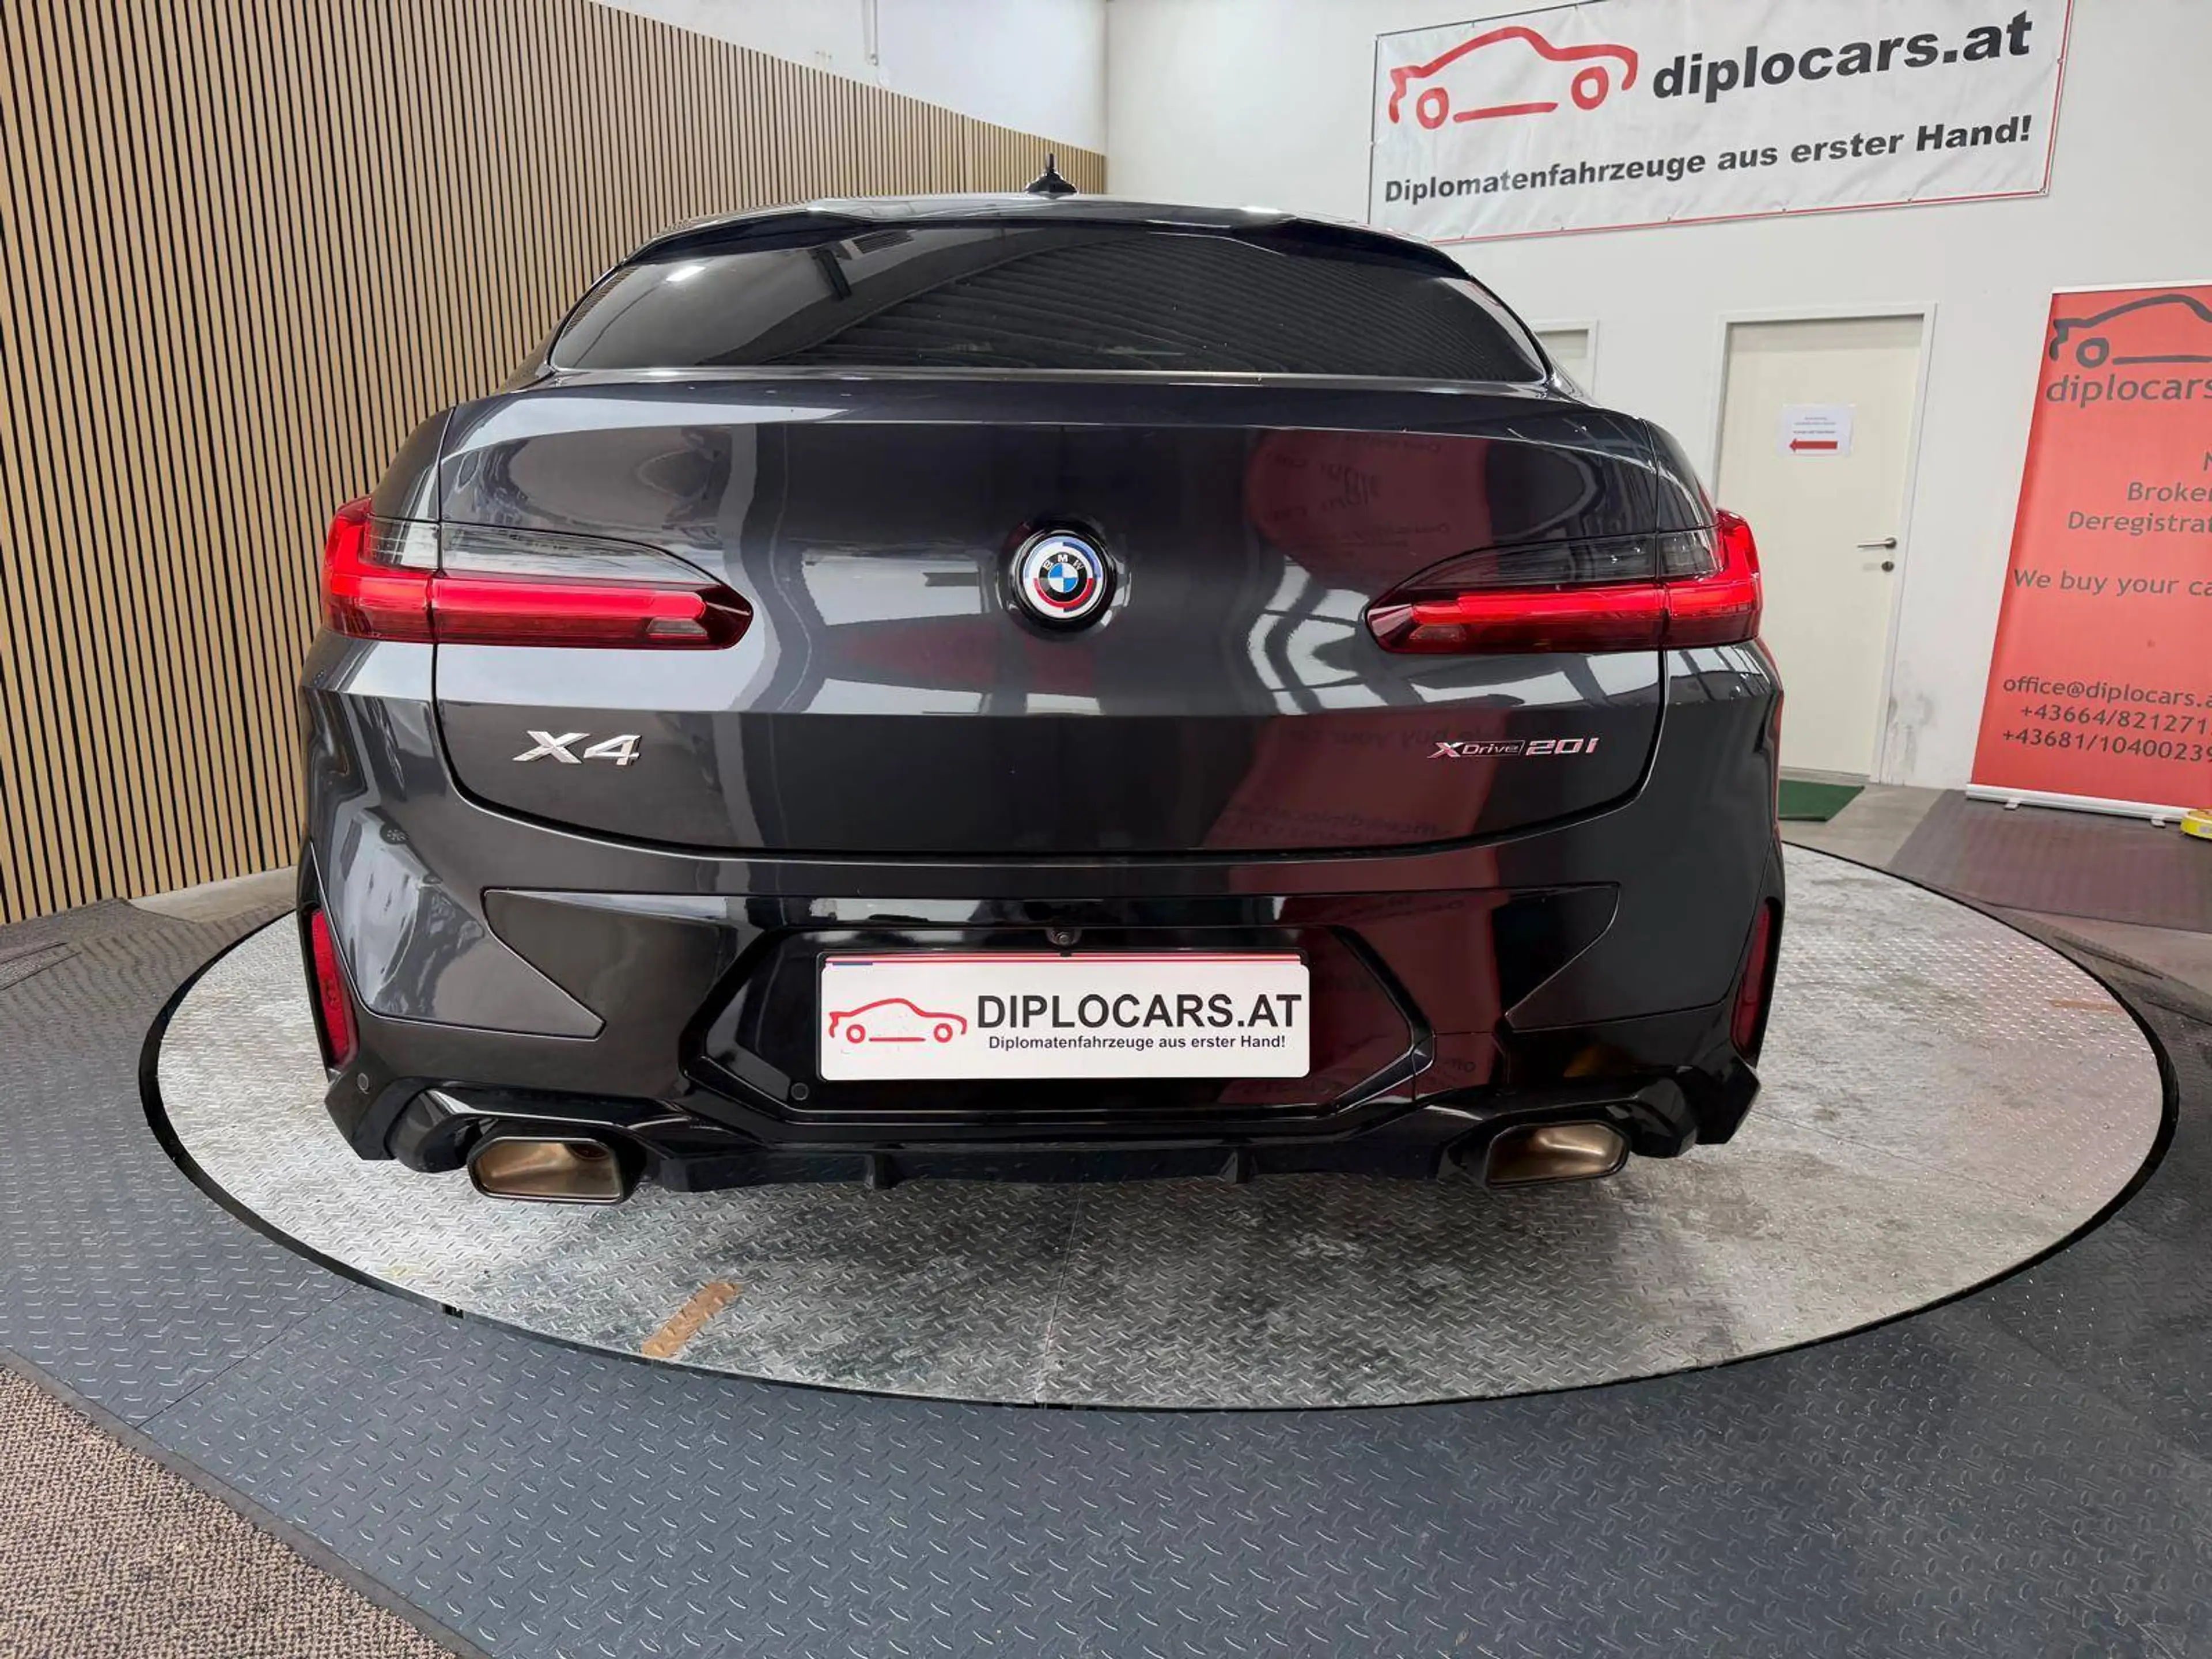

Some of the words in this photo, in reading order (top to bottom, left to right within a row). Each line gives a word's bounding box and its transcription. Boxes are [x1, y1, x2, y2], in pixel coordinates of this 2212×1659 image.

[1653, 10, 2033, 103] diplocars.at
[1385, 154, 1706, 205] Diplomatenfahrzeuge
[1718, 147, 1778, 171] aus
[1790, 132, 1905, 164] erster
[1915, 115, 2032, 152] Hand!
[1043, 554, 1085, 571] BMW
[2014, 569, 2051, 589] We
[2059, 570, 2108, 595] buy
[2116, 578, 2180, 597] your
[2020, 704, 2212, 735] +43664/821271
[512, 730, 642, 766] X4
[978, 994, 1302, 1029] DIPLOCARS.AT
[989, 1035, 1154, 1052] Diplomatenfahrzeuge
[1158, 1038, 1187, 1048] aus
[1191, 1036, 1236, 1048] erster
[1240, 1035, 1286, 1048] Hand!
